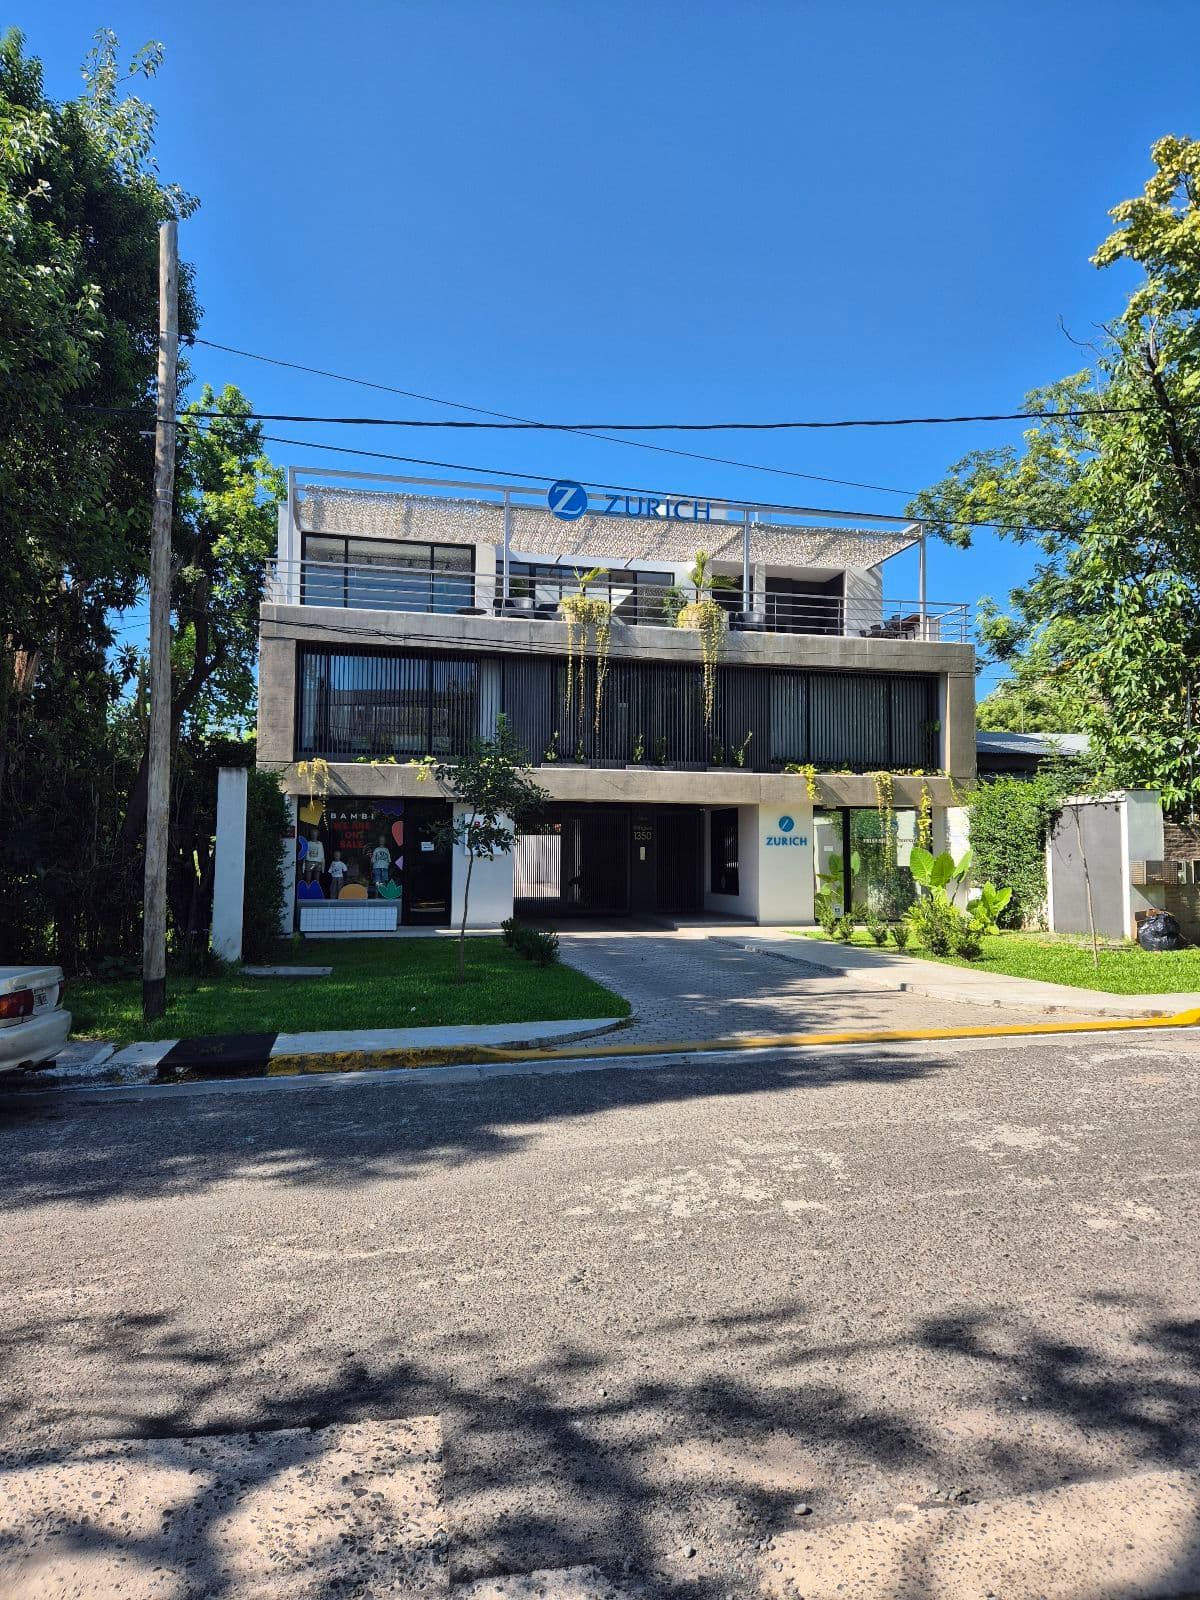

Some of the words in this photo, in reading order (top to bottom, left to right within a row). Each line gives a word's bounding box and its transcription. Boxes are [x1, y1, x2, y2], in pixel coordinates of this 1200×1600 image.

[604, 494, 710, 521] ZURICH
[330, 812, 374, 820] BAMBI
[633, 831, 652, 841] 1350
[339, 840, 364, 849] SALE
[766, 837, 808, 846] ZURICH
